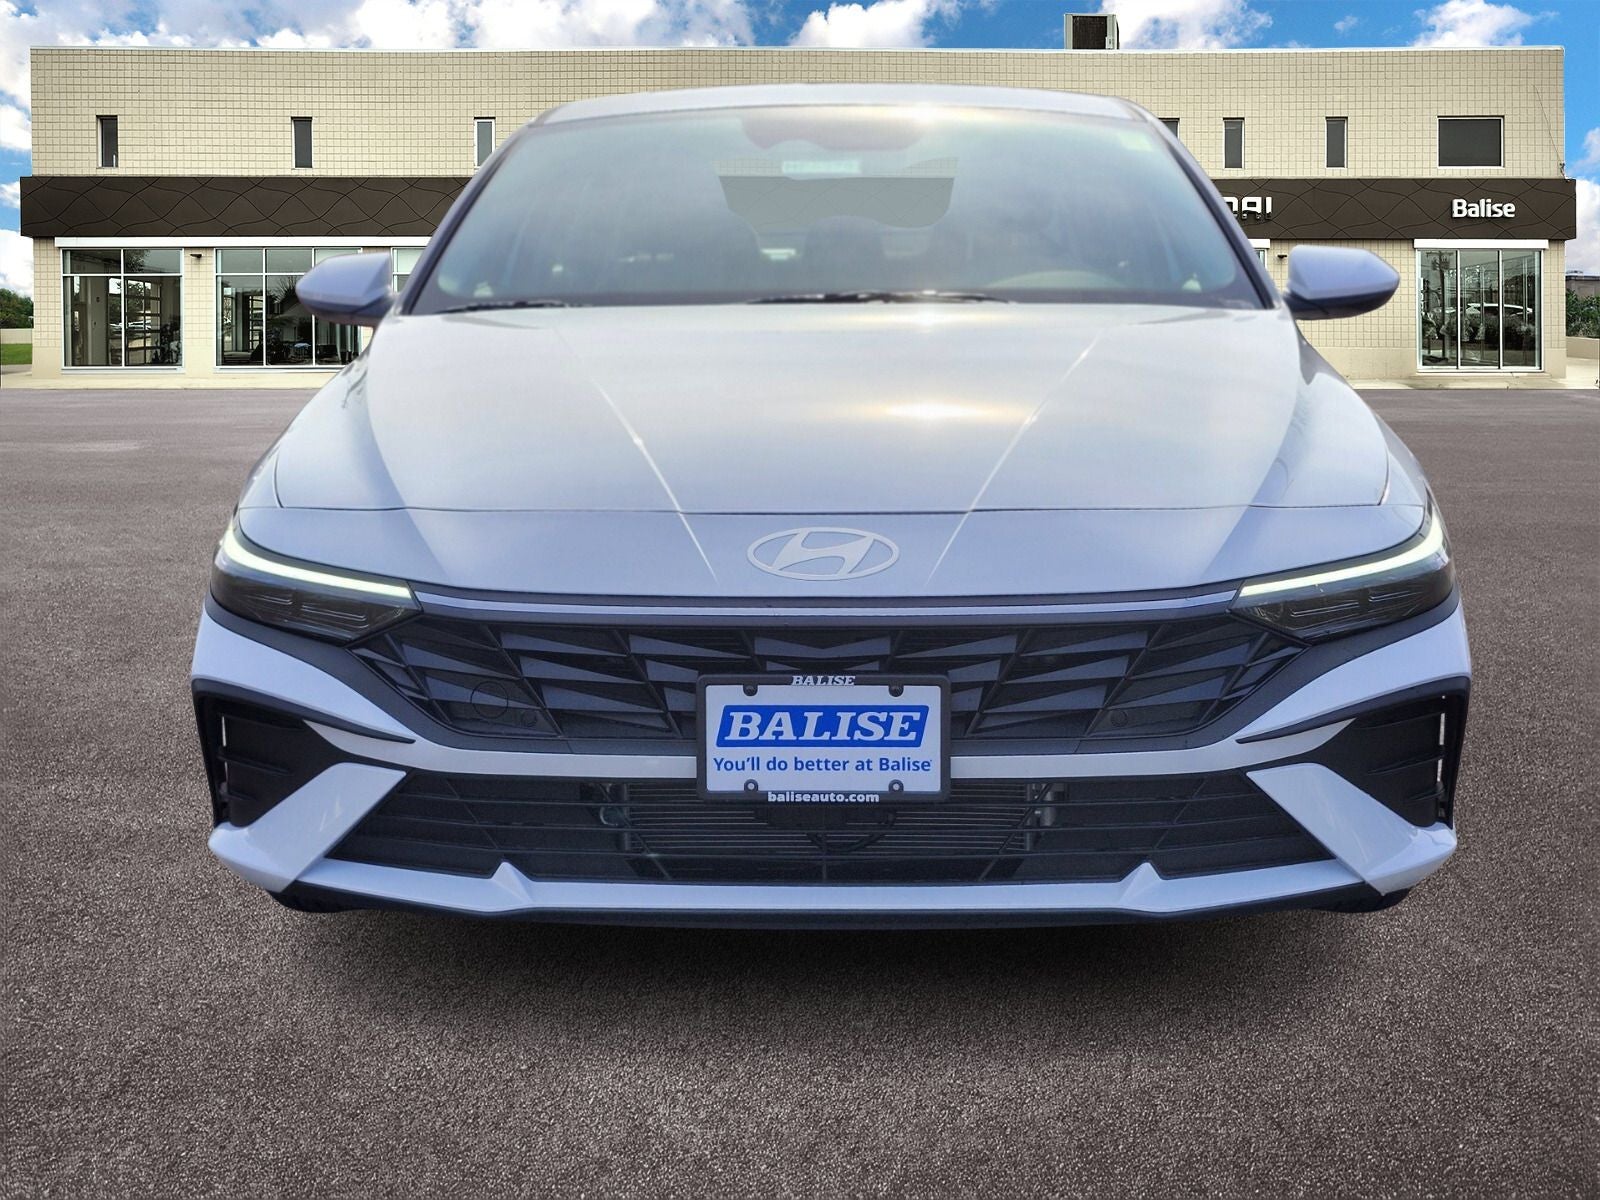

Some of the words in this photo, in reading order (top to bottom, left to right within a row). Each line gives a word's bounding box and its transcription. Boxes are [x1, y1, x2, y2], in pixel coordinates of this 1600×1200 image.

[1452, 199, 1516, 218] Balise
[791, 675, 856, 686] BALISE
[724, 711, 921, 741] BALISE
[766, 757, 788, 771] do
[794, 757, 849, 771] better
[855, 758, 873, 771] at
[879, 757, 932, 771] Balise
[767, 792, 880, 802] baliseauto.com
